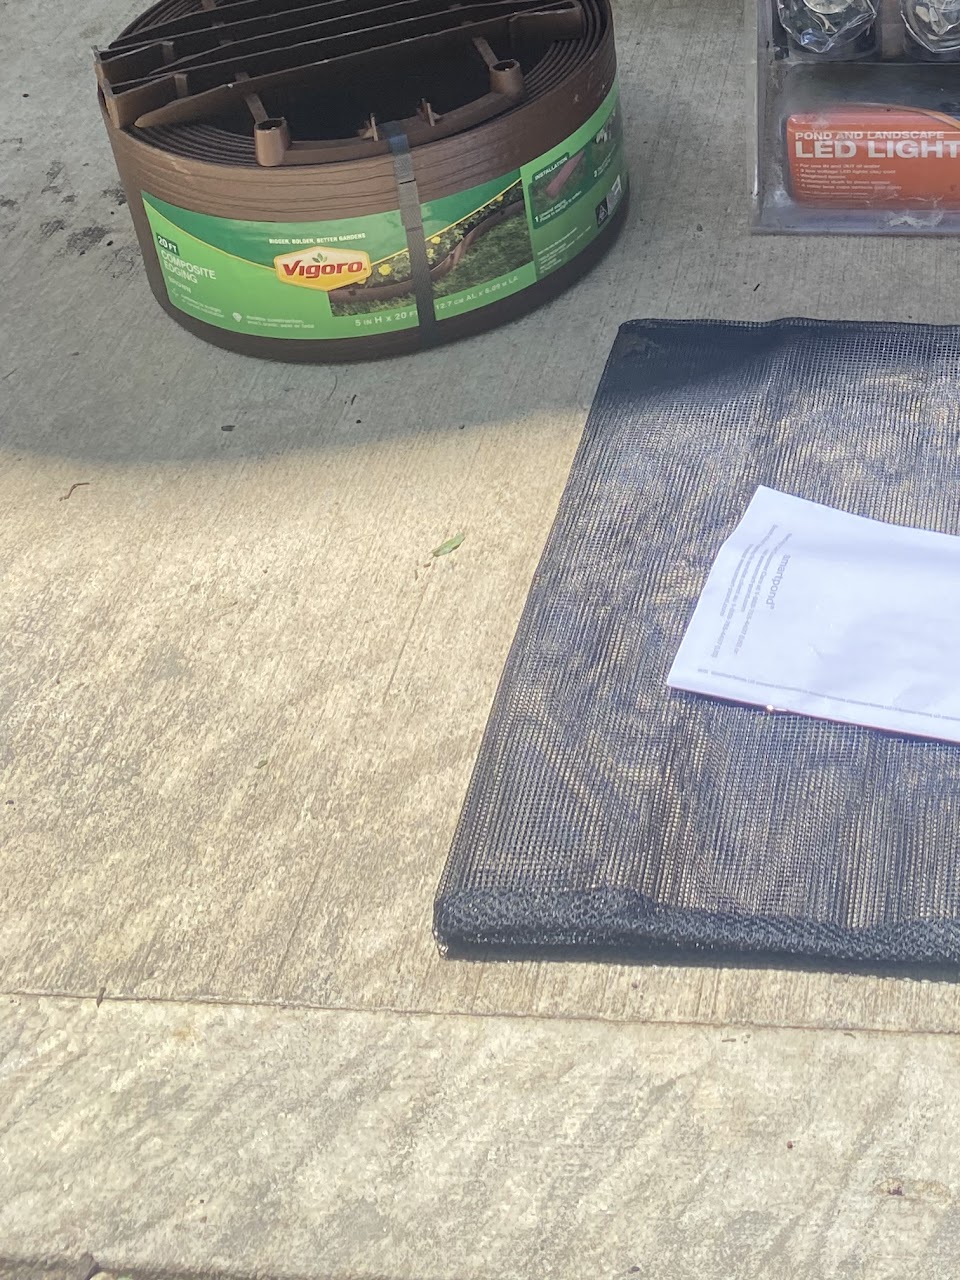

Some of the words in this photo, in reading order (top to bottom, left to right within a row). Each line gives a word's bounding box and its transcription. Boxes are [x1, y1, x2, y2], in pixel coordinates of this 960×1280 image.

[795, 131, 833, 140] POND
[836, 131, 864, 140] AND
[867, 130, 945, 139] LANDSCAPE
[795, 140, 857, 158] LED
[534, 155, 568, 181] INSTALLATION
[157, 235, 168, 248] 20
[168, 241, 177, 253] FT
[268, 237, 291, 245] BIGGER,
[292, 237, 315, 245] BOLDER,
[316, 235, 338, 243] BETTER
[338, 232, 366, 241] GARDENS
[160, 249, 217, 280] COMPOSITE
[163, 259, 198, 284] EDGING
[282, 260, 367, 279] Vigoro
[355, 319, 361, 327] 5
[375, 315, 382, 324] H
[394, 311, 407, 321] 20
[436, 300, 452, 311] 12.7
[466, 293, 477, 301] AL
[509, 275, 519, 284] LA
[765, 554, 791, 605] smartpond
